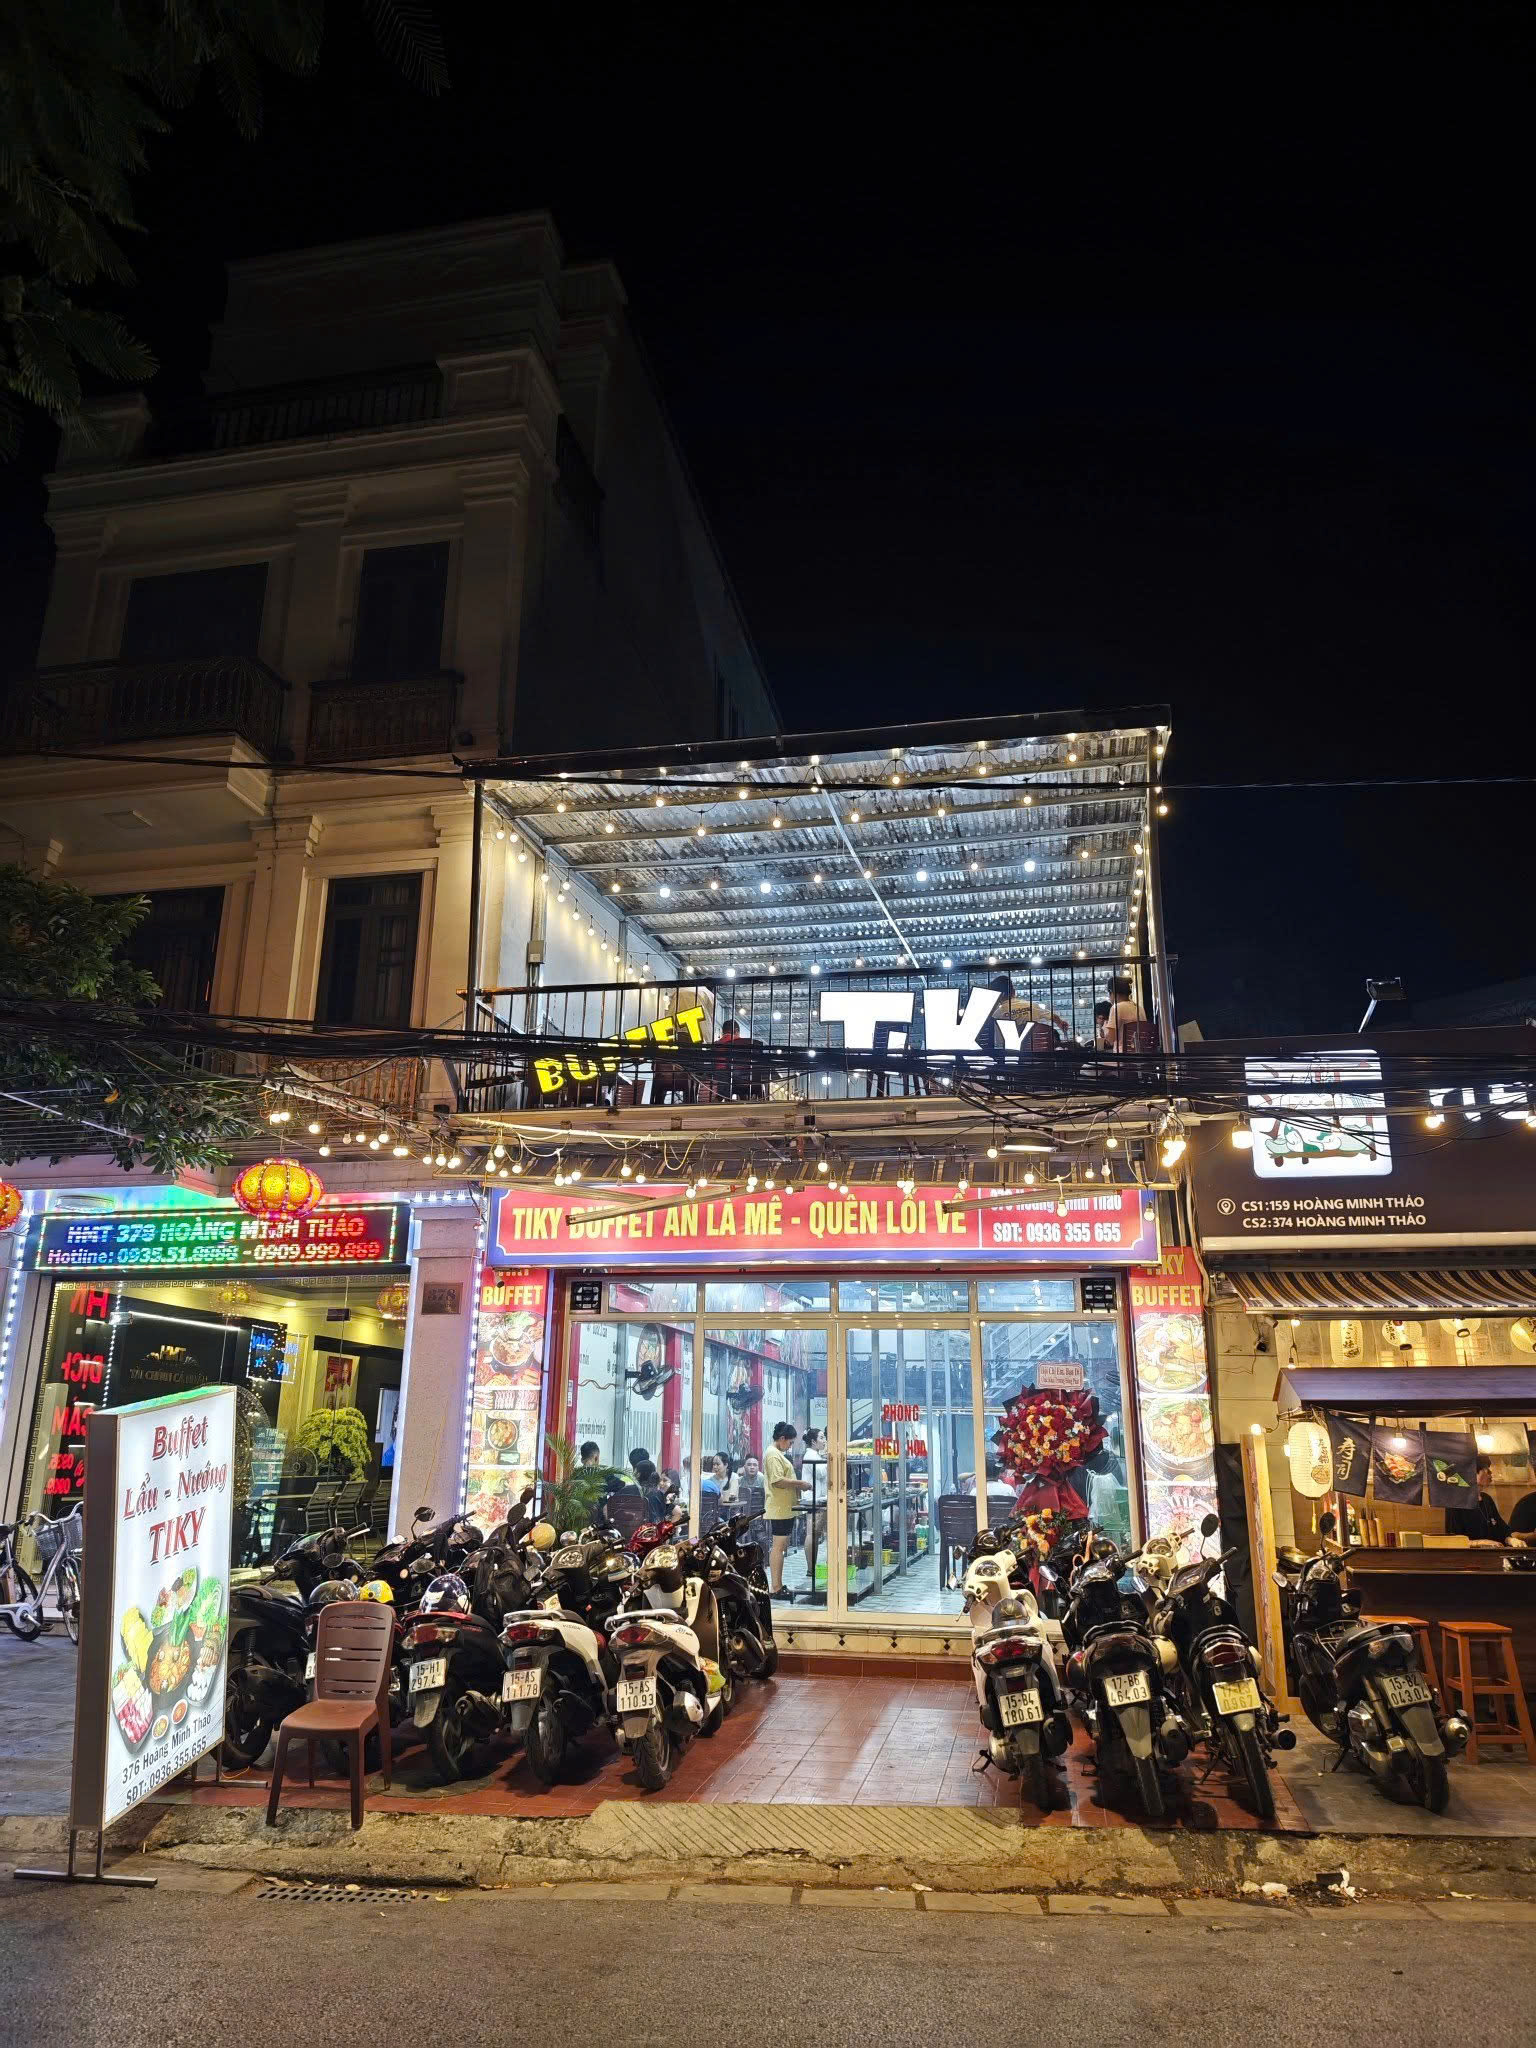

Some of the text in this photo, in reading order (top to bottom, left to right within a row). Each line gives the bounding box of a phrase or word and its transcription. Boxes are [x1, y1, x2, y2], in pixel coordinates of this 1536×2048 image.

[1293, 1196, 1344, 1211] HOÀNG
[1346, 1198, 1384, 1209] MINH
[1385, 1194, 1425, 1208] THẢO
[512, 1207, 563, 1240] TIKY
[744, 1194, 783, 1236] MÊ
[790, 1216, 801, 1225] -
[809, 1193, 878, 1239] QUÊN
[1242, 1211, 1427, 1229] CS2:374 HOÀNG MINH THẢO
[159, 1216, 236, 1242] HOÀNG
[993, 1222, 1122, 1243] SĐT: 0936 355 655
[47, 1248, 114, 1264] Hotline:
[1146, 1254, 1185, 1276] KY
[482, 1284, 544, 1306] BUFFET
[1132, 1284, 1201, 1307] BUFFET
[881, 1400, 919, 1422] PHÒNG
[152, 1415, 209, 1461] Buffet
[1336, 1435, 1356, 1481] 寿司
[123, 1472, 159, 1522] Lẩu
[164, 1488, 172, 1499] -
[177, 1460, 228, 1501] Nướng
[149, 1506, 206, 1566] TIKY
[416, 1661, 440, 1677] 15-H1
[411, 1675, 441, 1691] 297.4
[624, 1681, 650, 1696] 15-AS
[1112, 1674, 1140, 1690] 17-B6
[1389, 1673, 1420, 1691] 15-B2
[620, 1693, 655, 1710] 110.93
[1005, 1691, 1034, 1710] 15-B4
[1111, 1686, 1147, 1705] 464.03
[1005, 1705, 1042, 1725] 180.61
[122, 1711, 212, 1785] 376 Hoàng Minh Thảo
